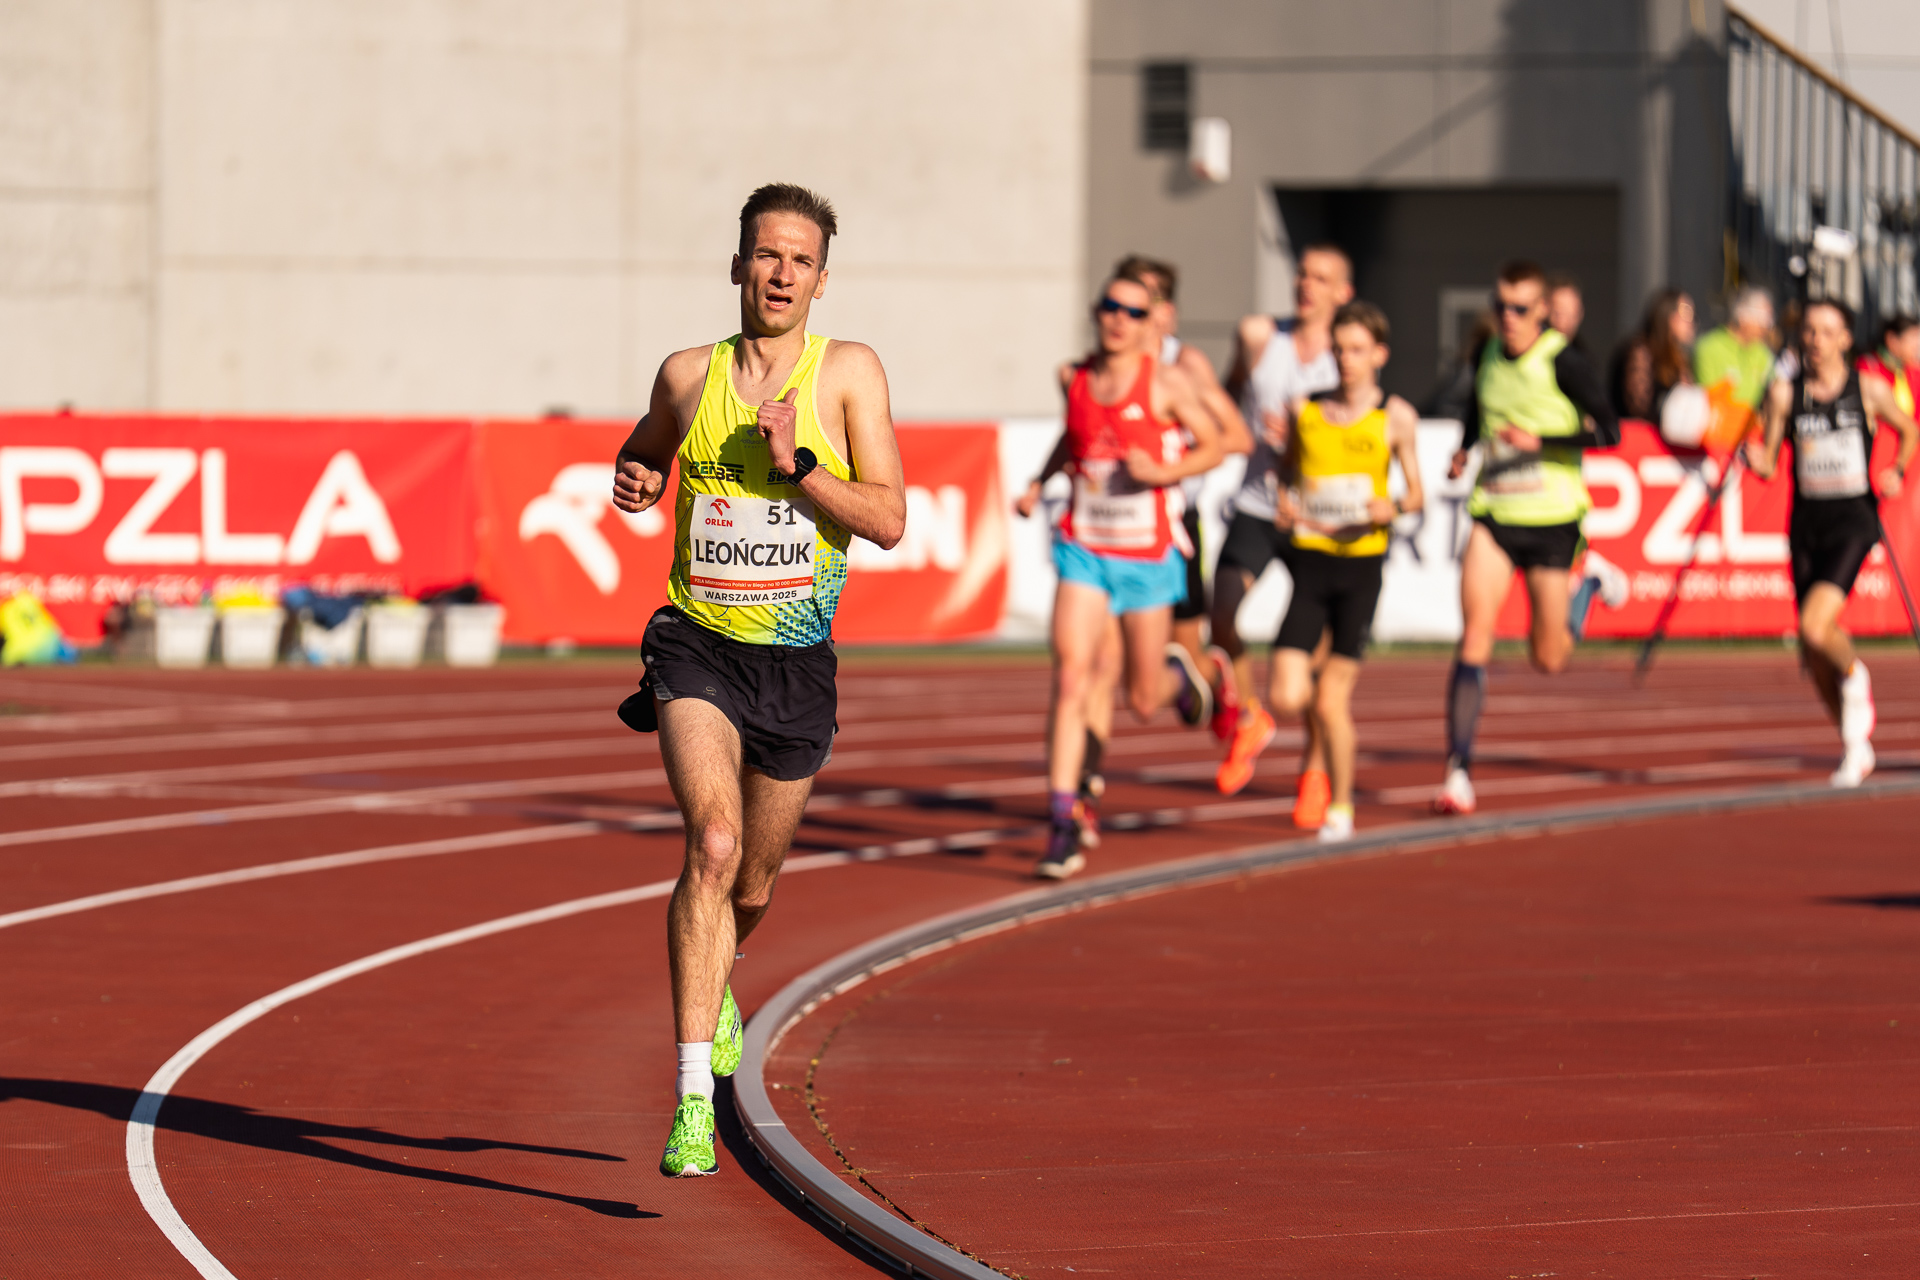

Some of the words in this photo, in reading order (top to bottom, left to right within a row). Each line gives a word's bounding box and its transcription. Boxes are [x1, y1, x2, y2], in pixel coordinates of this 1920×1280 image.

[0, 446, 402, 565] PZLA
[766, 504, 797, 526] 51
[705, 518, 733, 528] ORLEN
[694, 538, 812, 567] LEOŃCZUK
[704, 590, 770, 602] WARSZAWA
[771, 590, 797, 600] 2025
